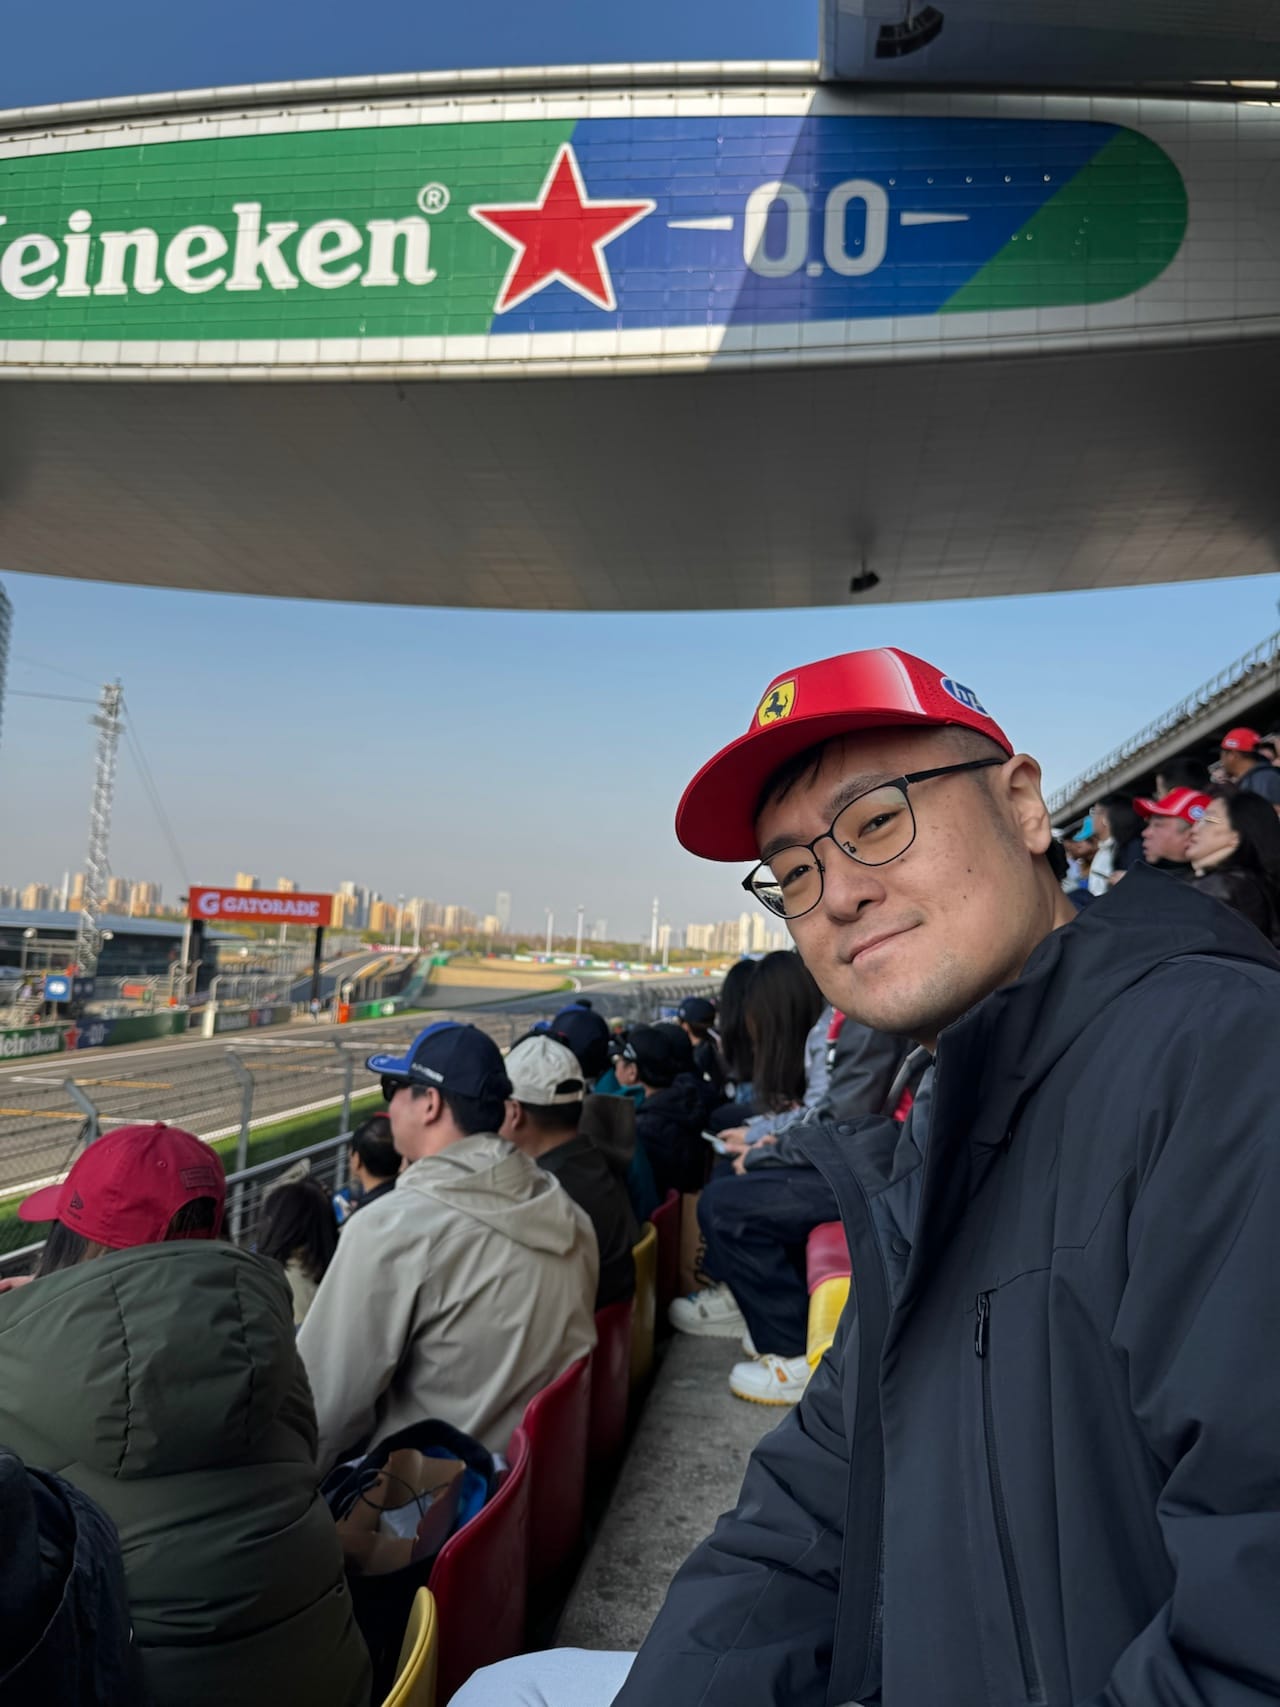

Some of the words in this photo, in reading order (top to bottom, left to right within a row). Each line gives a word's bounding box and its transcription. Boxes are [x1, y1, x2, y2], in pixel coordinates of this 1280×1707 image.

[0, 202, 436, 299] eineken
[743, 179, 889, 278] 0.0
[222, 896, 320, 917] GATORADE
